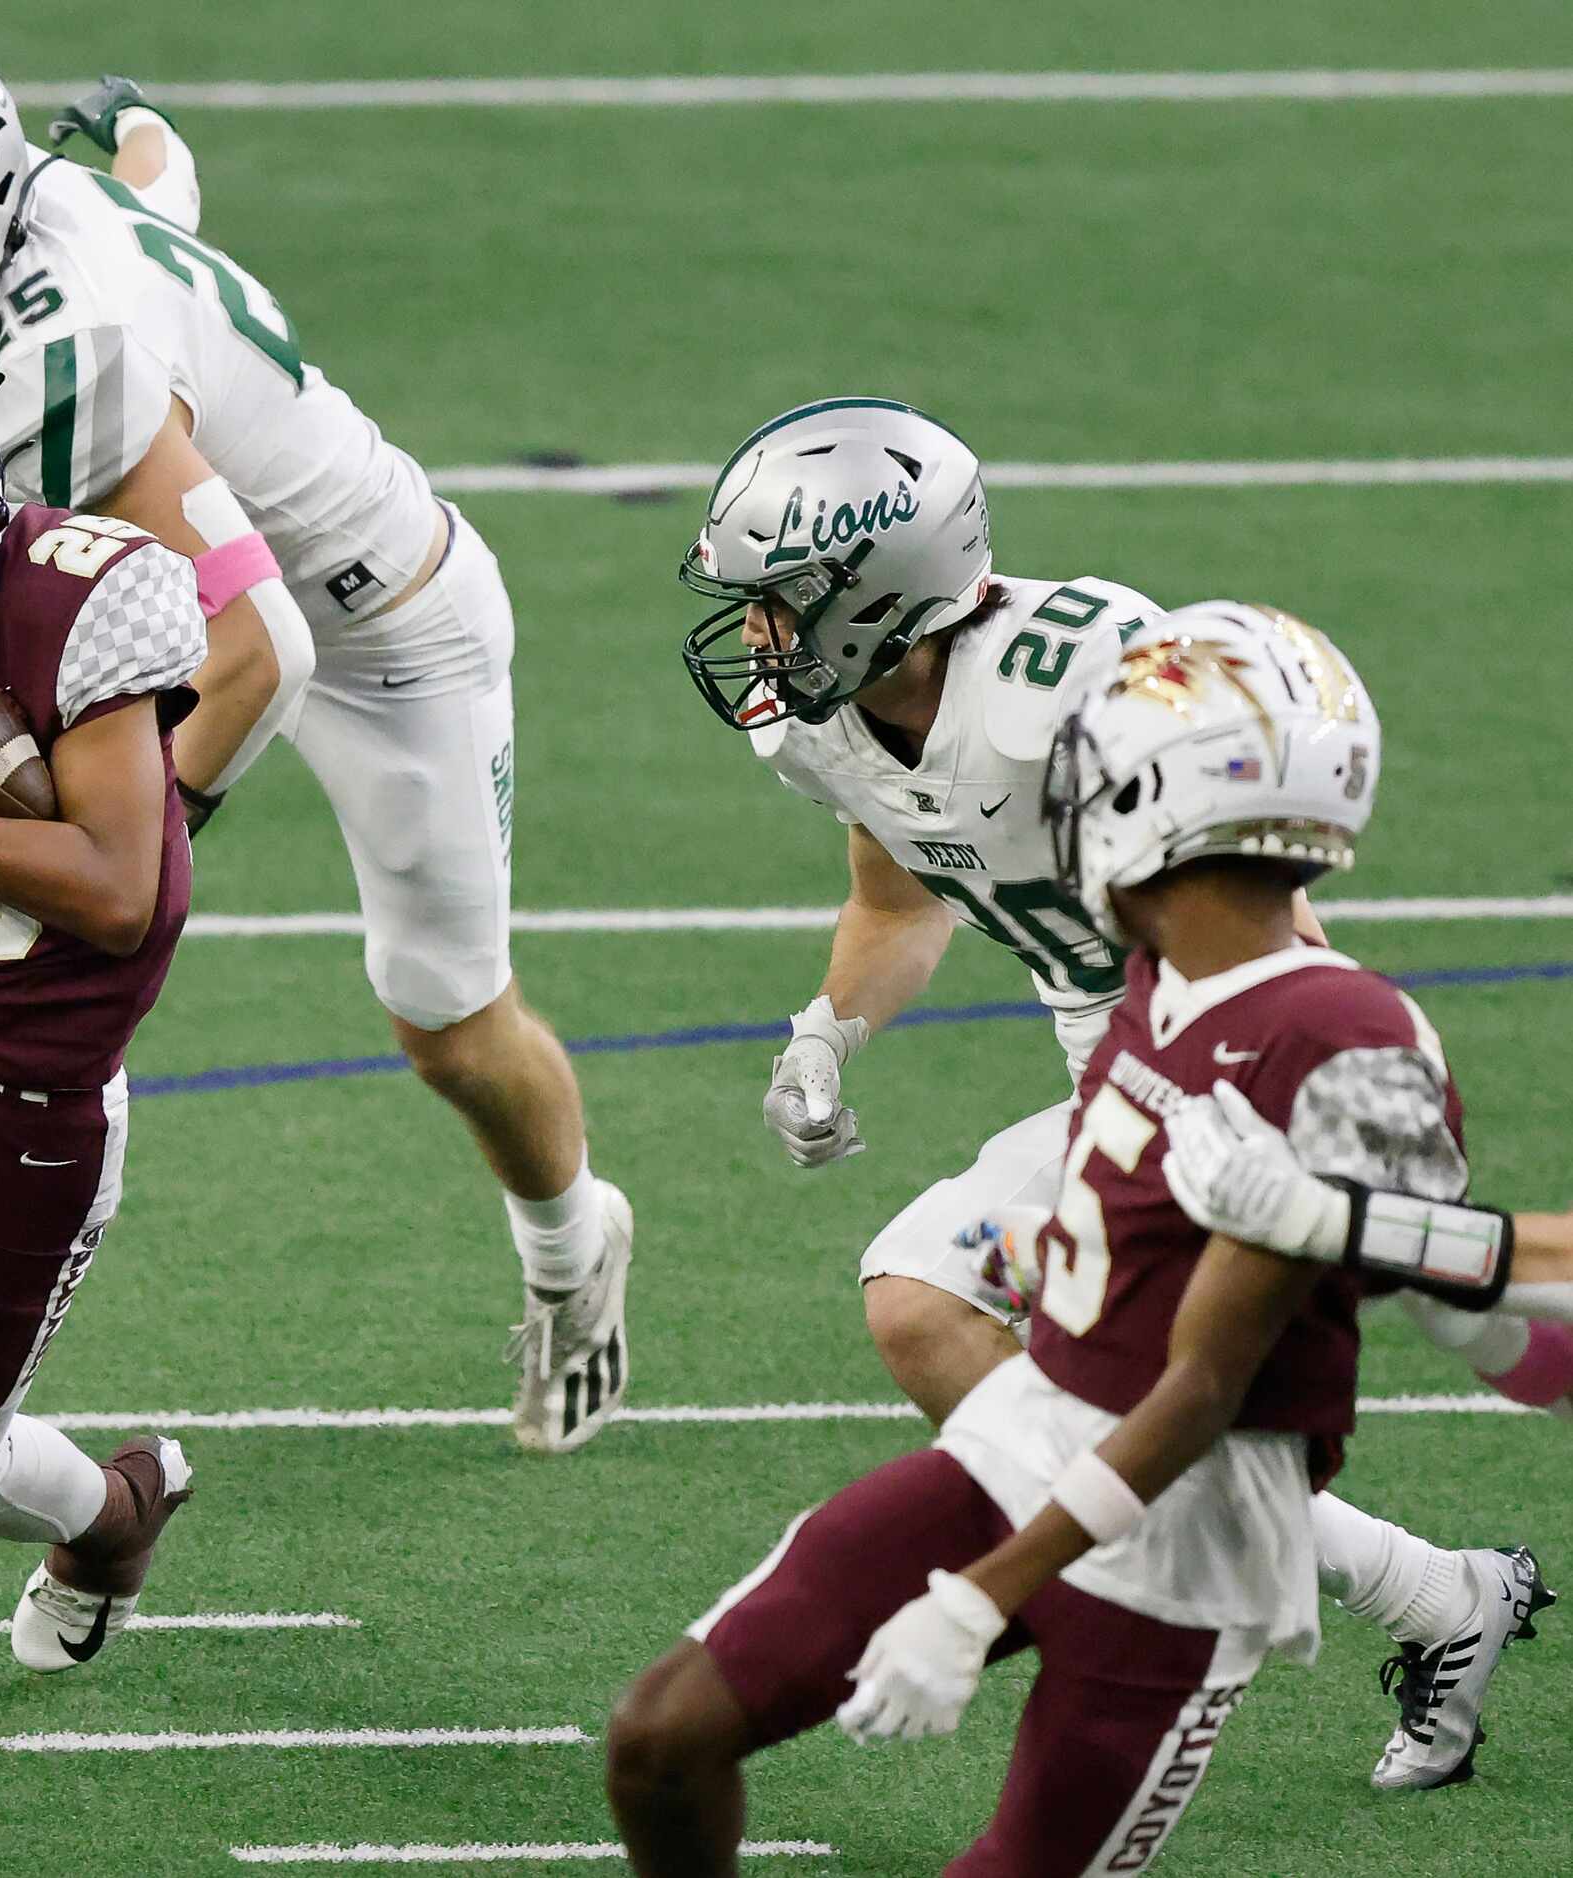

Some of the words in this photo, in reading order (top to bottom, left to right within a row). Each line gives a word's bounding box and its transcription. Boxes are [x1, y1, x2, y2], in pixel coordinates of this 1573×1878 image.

[764, 480, 919, 570] Lions
[996, 585, 1113, 690] 20
[908, 839, 987, 872] REEDY
[1040, 1082, 1158, 1339] 5
[1107, 1683, 1247, 1872] COYOTES
